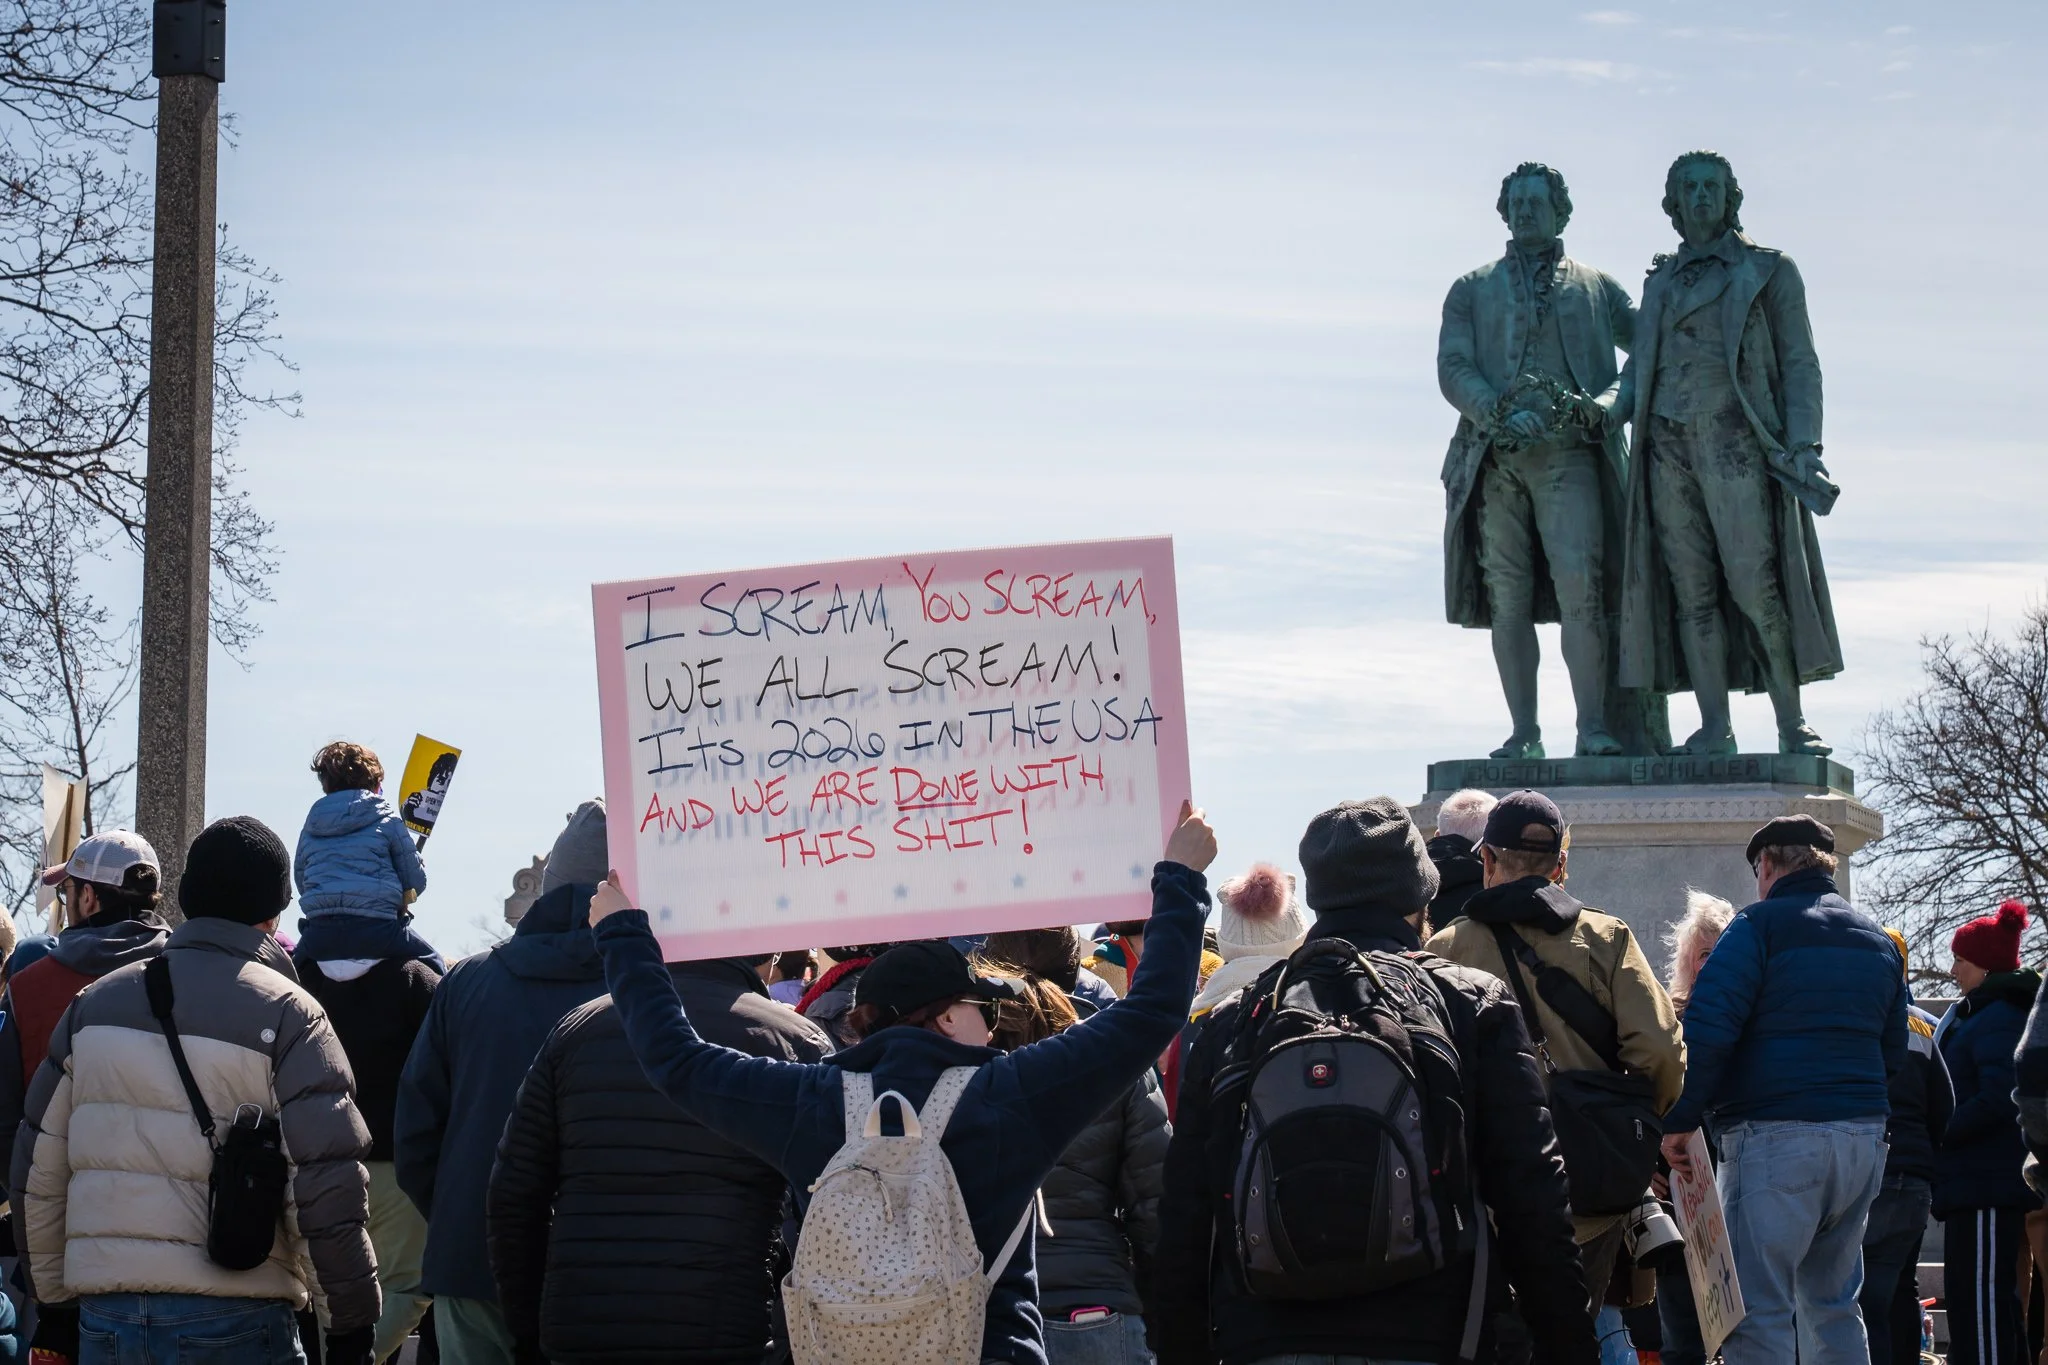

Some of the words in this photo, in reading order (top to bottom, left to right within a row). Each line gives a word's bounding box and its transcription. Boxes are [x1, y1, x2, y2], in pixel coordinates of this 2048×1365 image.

[625, 585, 686, 650] I
[699, 580, 895, 642] SCREAM,
[984, 569, 1157, 625] SCREAM,
[645, 657, 723, 714] WE
[755, 655, 858, 708] ALL
[884, 625, 1122, 694] SCREAM!
[768, 717, 886, 768] 2026
[899, 721, 964, 751] IN
[968, 701, 1061, 749] THE
[1072, 697, 1164, 747] USA
[640, 792, 715, 833] AND
[732, 774, 789, 817] WE
[810, 766, 880, 813] ARE
[890, 767, 979, 808] DONE
[990, 753, 1104, 795] WITH
[1467, 764, 1568, 784] GOETHE
[1633, 759, 1762, 781] SCHILLER
[765, 829, 877, 868] THIS
[896, 798, 1035, 856] SHIT!
